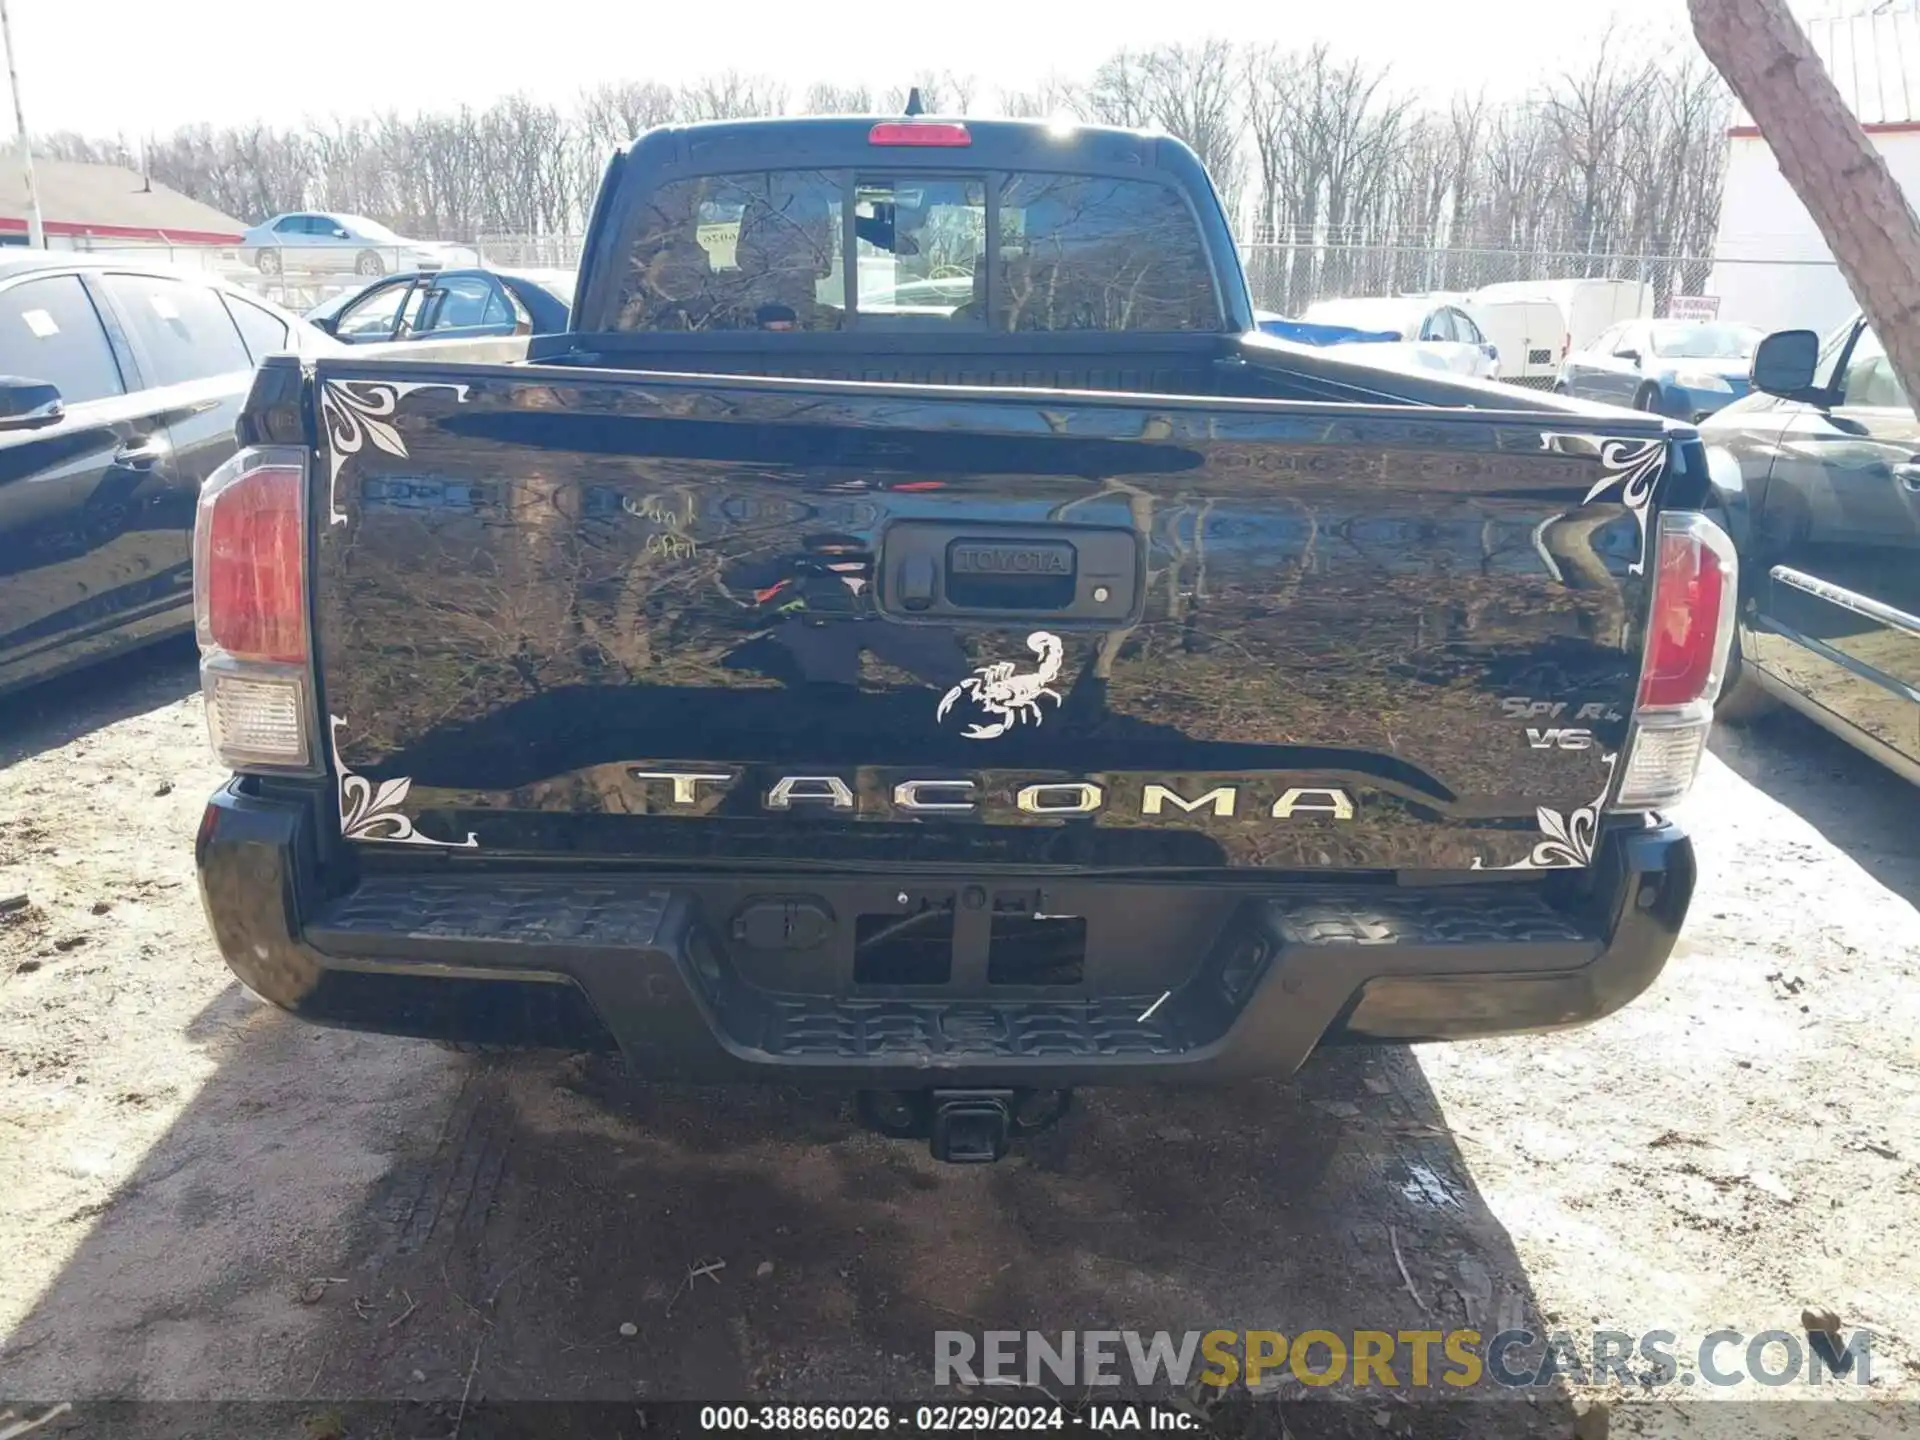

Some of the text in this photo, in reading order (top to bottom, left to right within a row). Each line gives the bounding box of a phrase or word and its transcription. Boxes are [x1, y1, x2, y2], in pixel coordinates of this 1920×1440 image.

[963, 550, 1067, 572] TOYOTA
[1525, 728, 1592, 750] V6
[637, 771, 1355, 820] TACOMA
